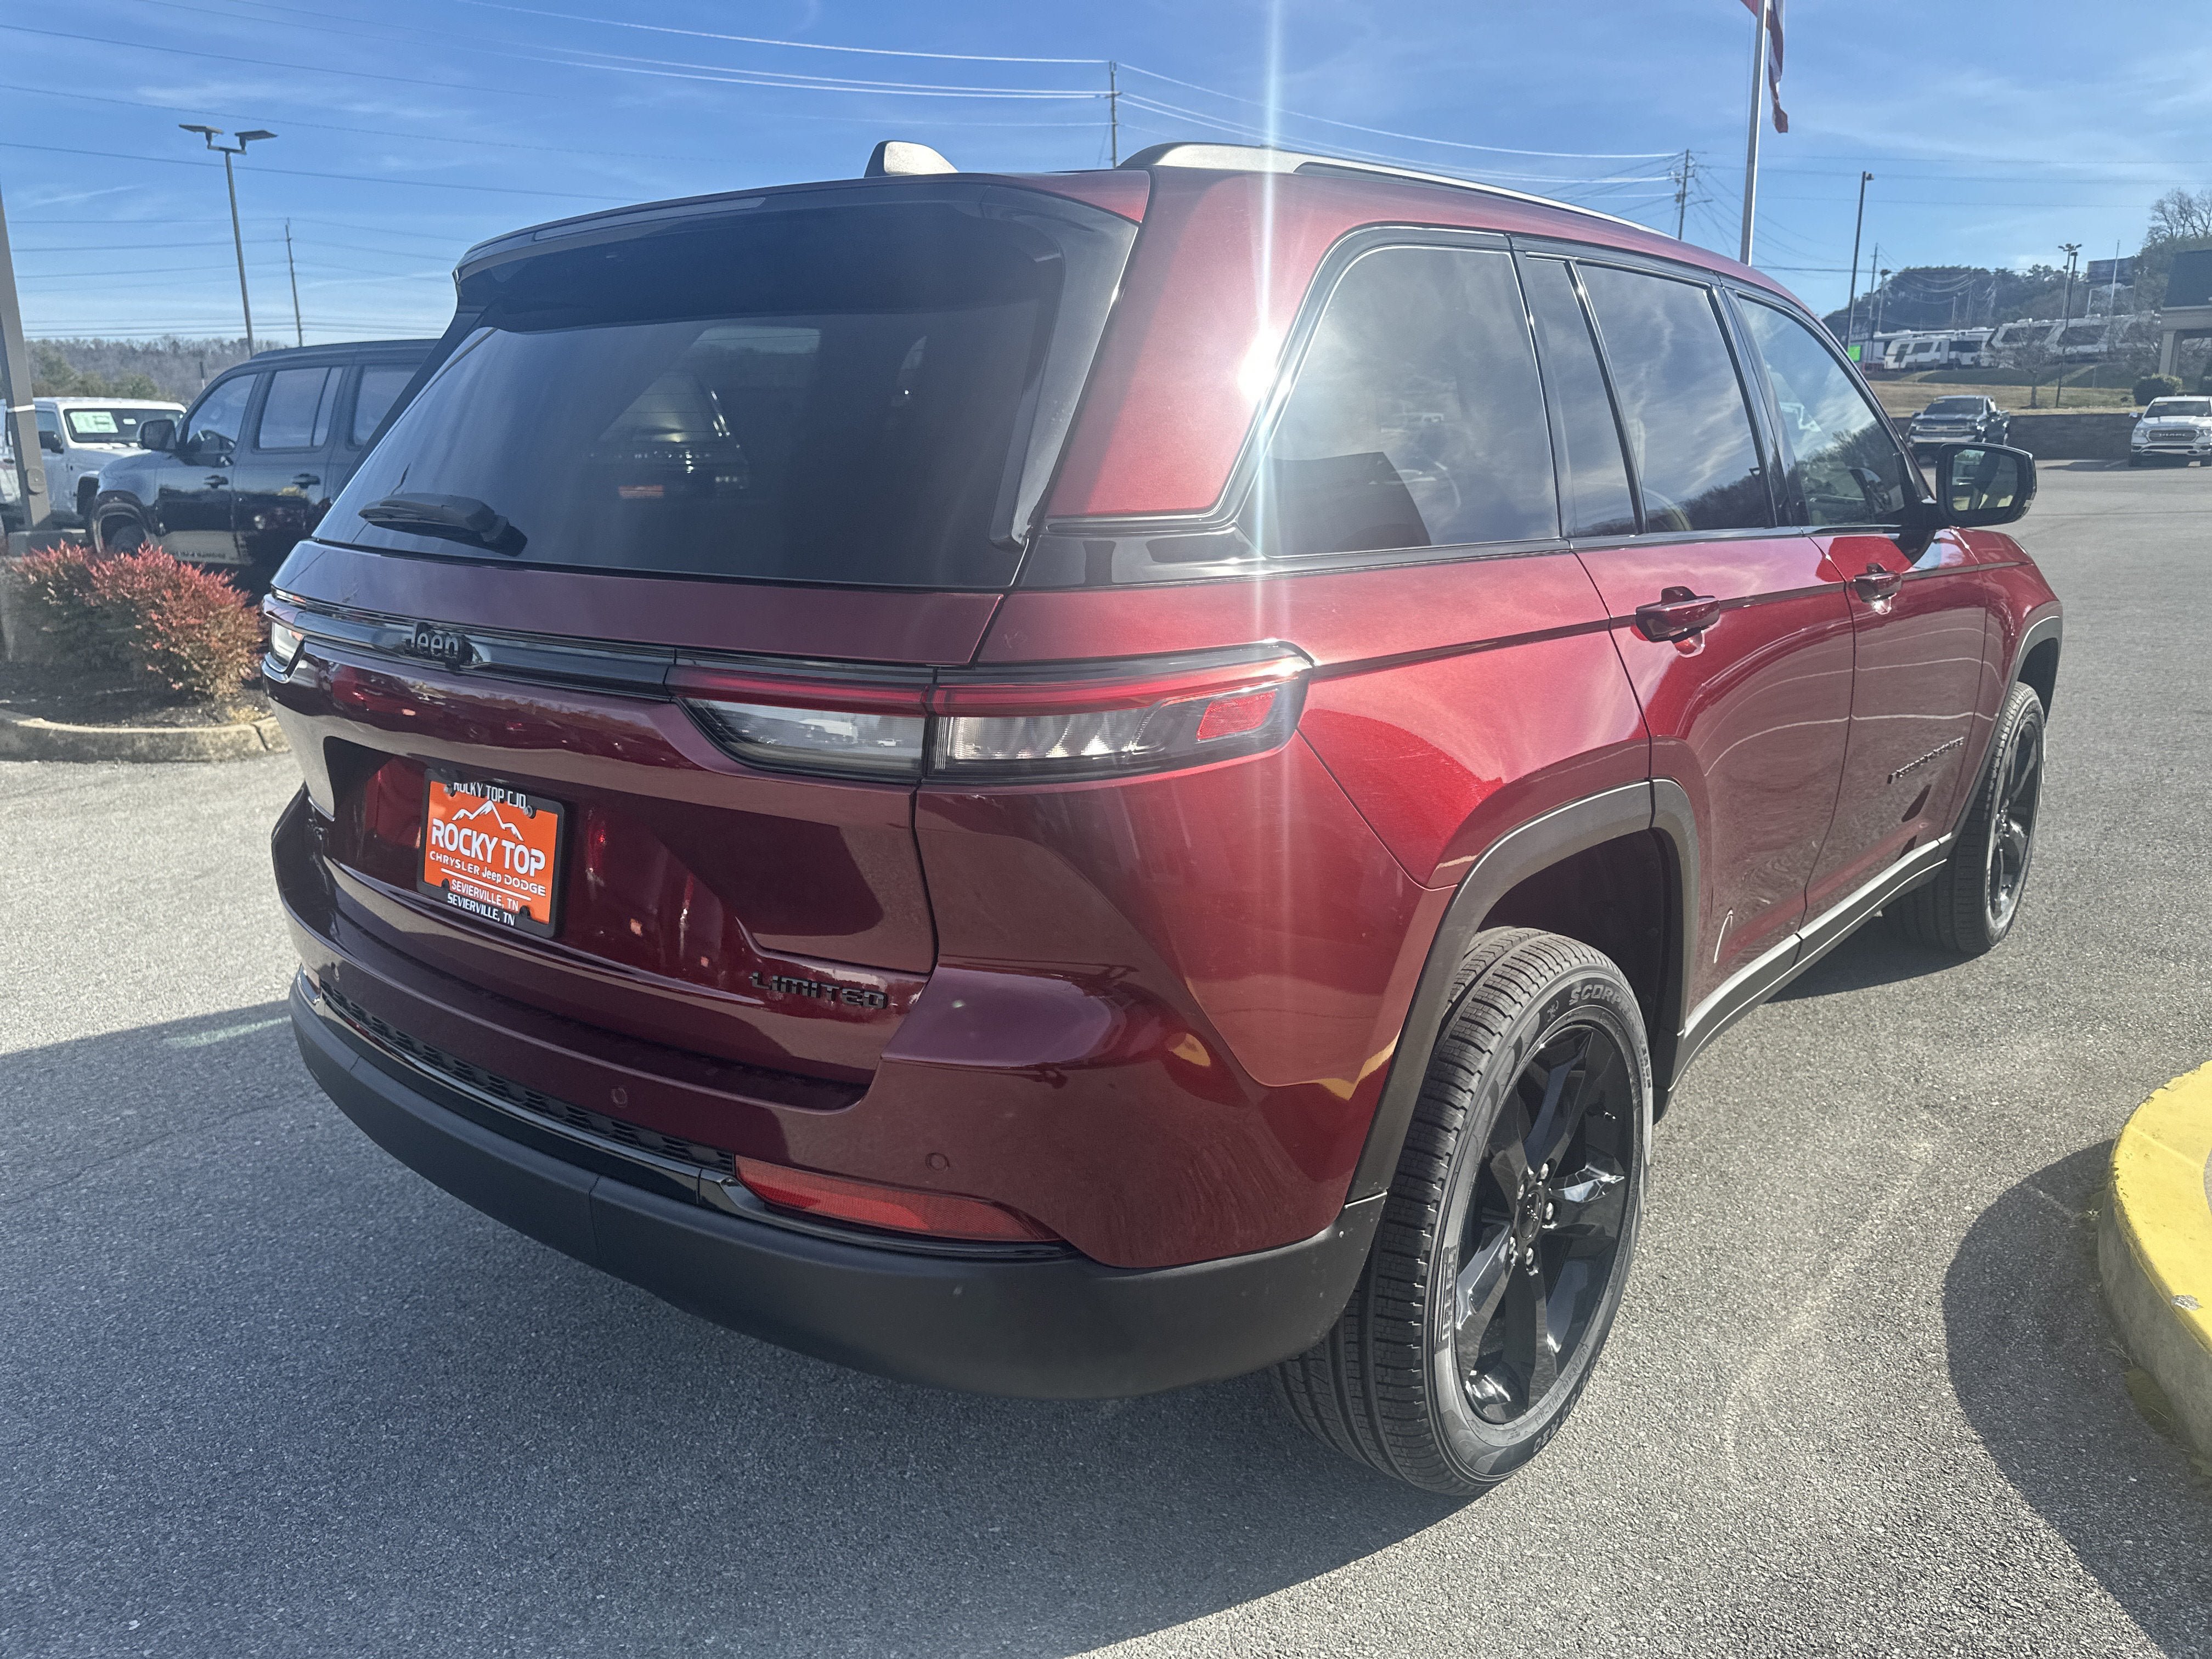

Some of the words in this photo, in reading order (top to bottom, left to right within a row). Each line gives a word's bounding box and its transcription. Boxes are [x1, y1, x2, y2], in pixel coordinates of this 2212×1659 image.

[405, 622, 465, 671] Jeep
[486, 785, 505, 803] TOP
[507, 791, 527, 809] CJD
[431, 818, 499, 864] ROCKY
[501, 839, 546, 877] TOP
[430, 851, 481, 876] CHRYSLER
[482, 866, 502, 884] Jeep
[504, 874, 546, 897] DODGE
[447, 892, 500, 921] SEVIERVILLE,
[503, 911, 516, 926] TN
[452, 879, 504, 909] SEVIERVILLE,
[506, 898, 519, 912] TN
[751, 972, 888, 1009] LIMITED
